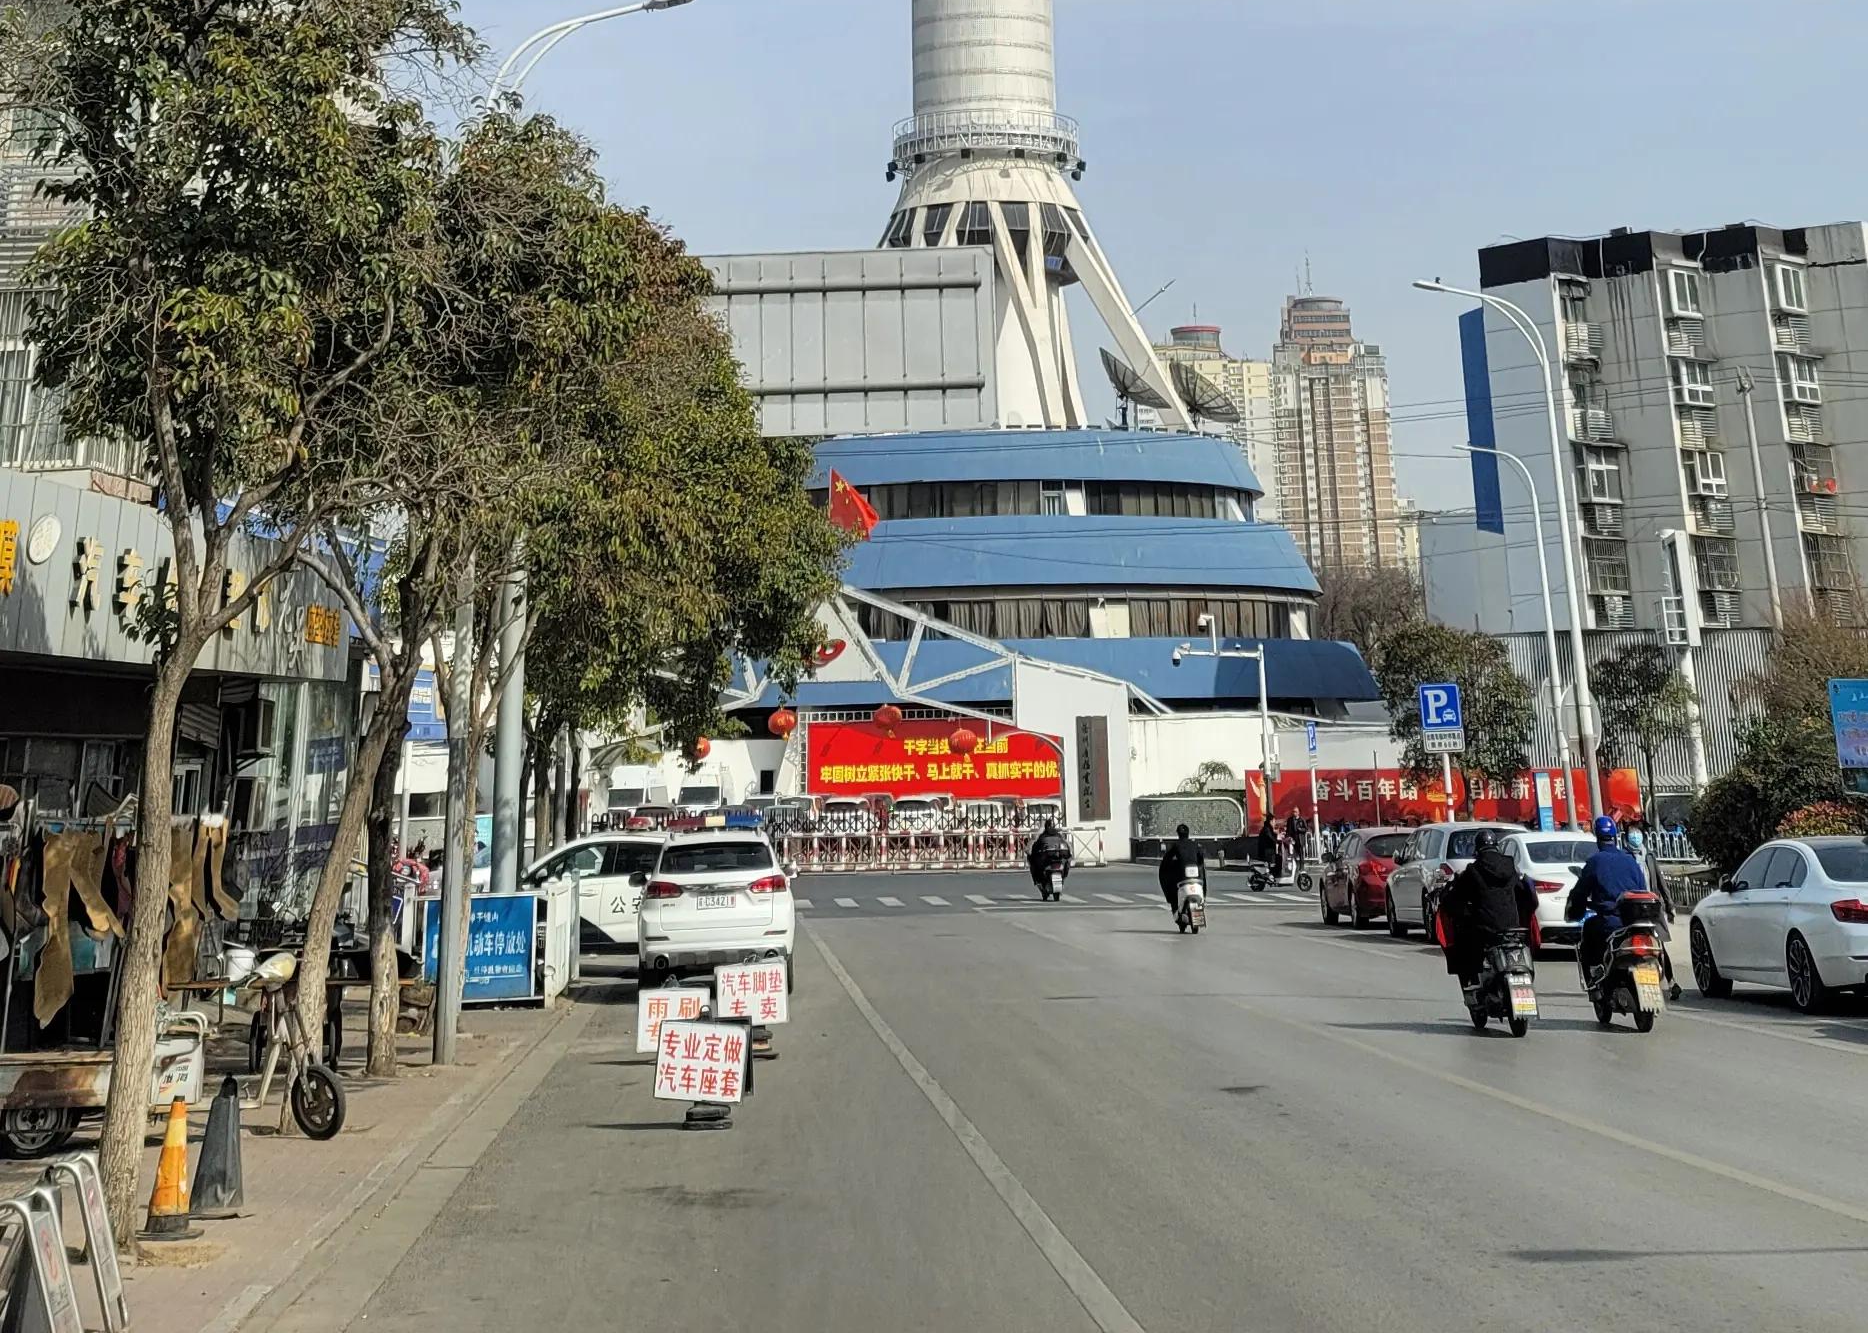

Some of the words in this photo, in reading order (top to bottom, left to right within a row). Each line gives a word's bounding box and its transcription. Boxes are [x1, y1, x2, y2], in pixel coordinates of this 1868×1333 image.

[1423, 689, 1448, 724] P
[1316, 778, 1418, 802] 奋斗百年路
[721, 969, 783, 997] 汽车脚垫
[661, 1029, 744, 1065] 专业定做
[658, 1063, 740, 1098] 汽车座套
